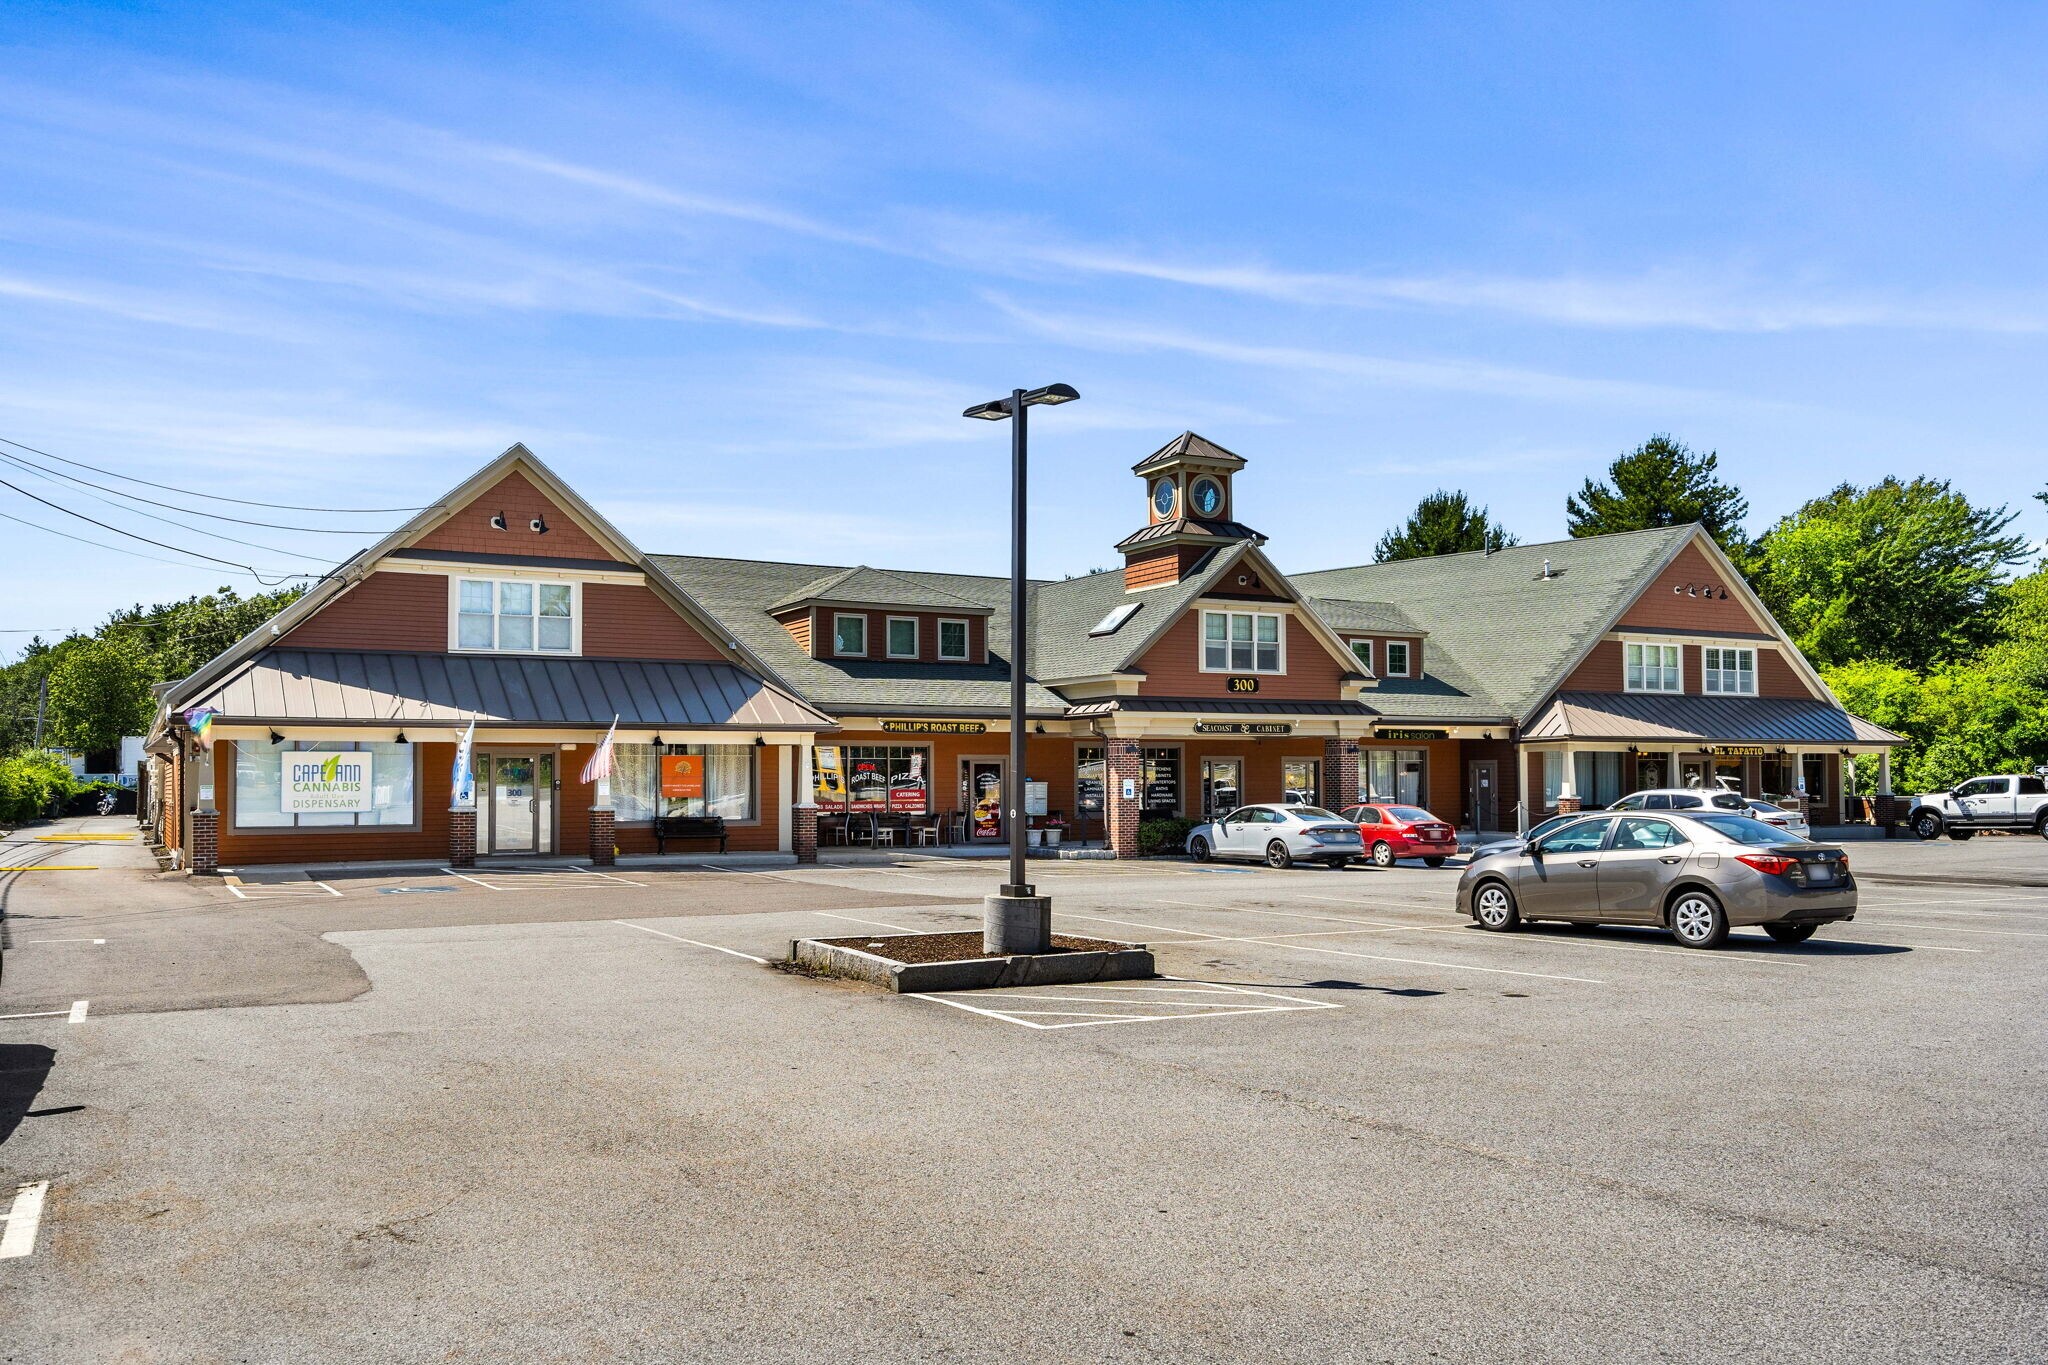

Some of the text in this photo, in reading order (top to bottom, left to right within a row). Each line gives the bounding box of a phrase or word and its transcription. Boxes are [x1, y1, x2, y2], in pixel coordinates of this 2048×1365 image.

[1233, 679, 1254, 691] 300
[889, 722, 980, 733] PHILLIP'S ROAST BEEF
[1202, 724, 1232, 732] SEACOAST
[1256, 725, 1284, 733] CABINET
[1388, 730, 1435, 739] iris salon
[1714, 747, 1763, 755] EL TAPATIO
[856, 763, 876, 771] OPEN
[293, 764, 361, 782] CAPE ANN
[851, 772, 886, 785] ROAST BEEF
[293, 782, 361, 792] CANNABIS
[507, 789, 522, 797] 300
[293, 799, 361, 808] DISPENSARY
